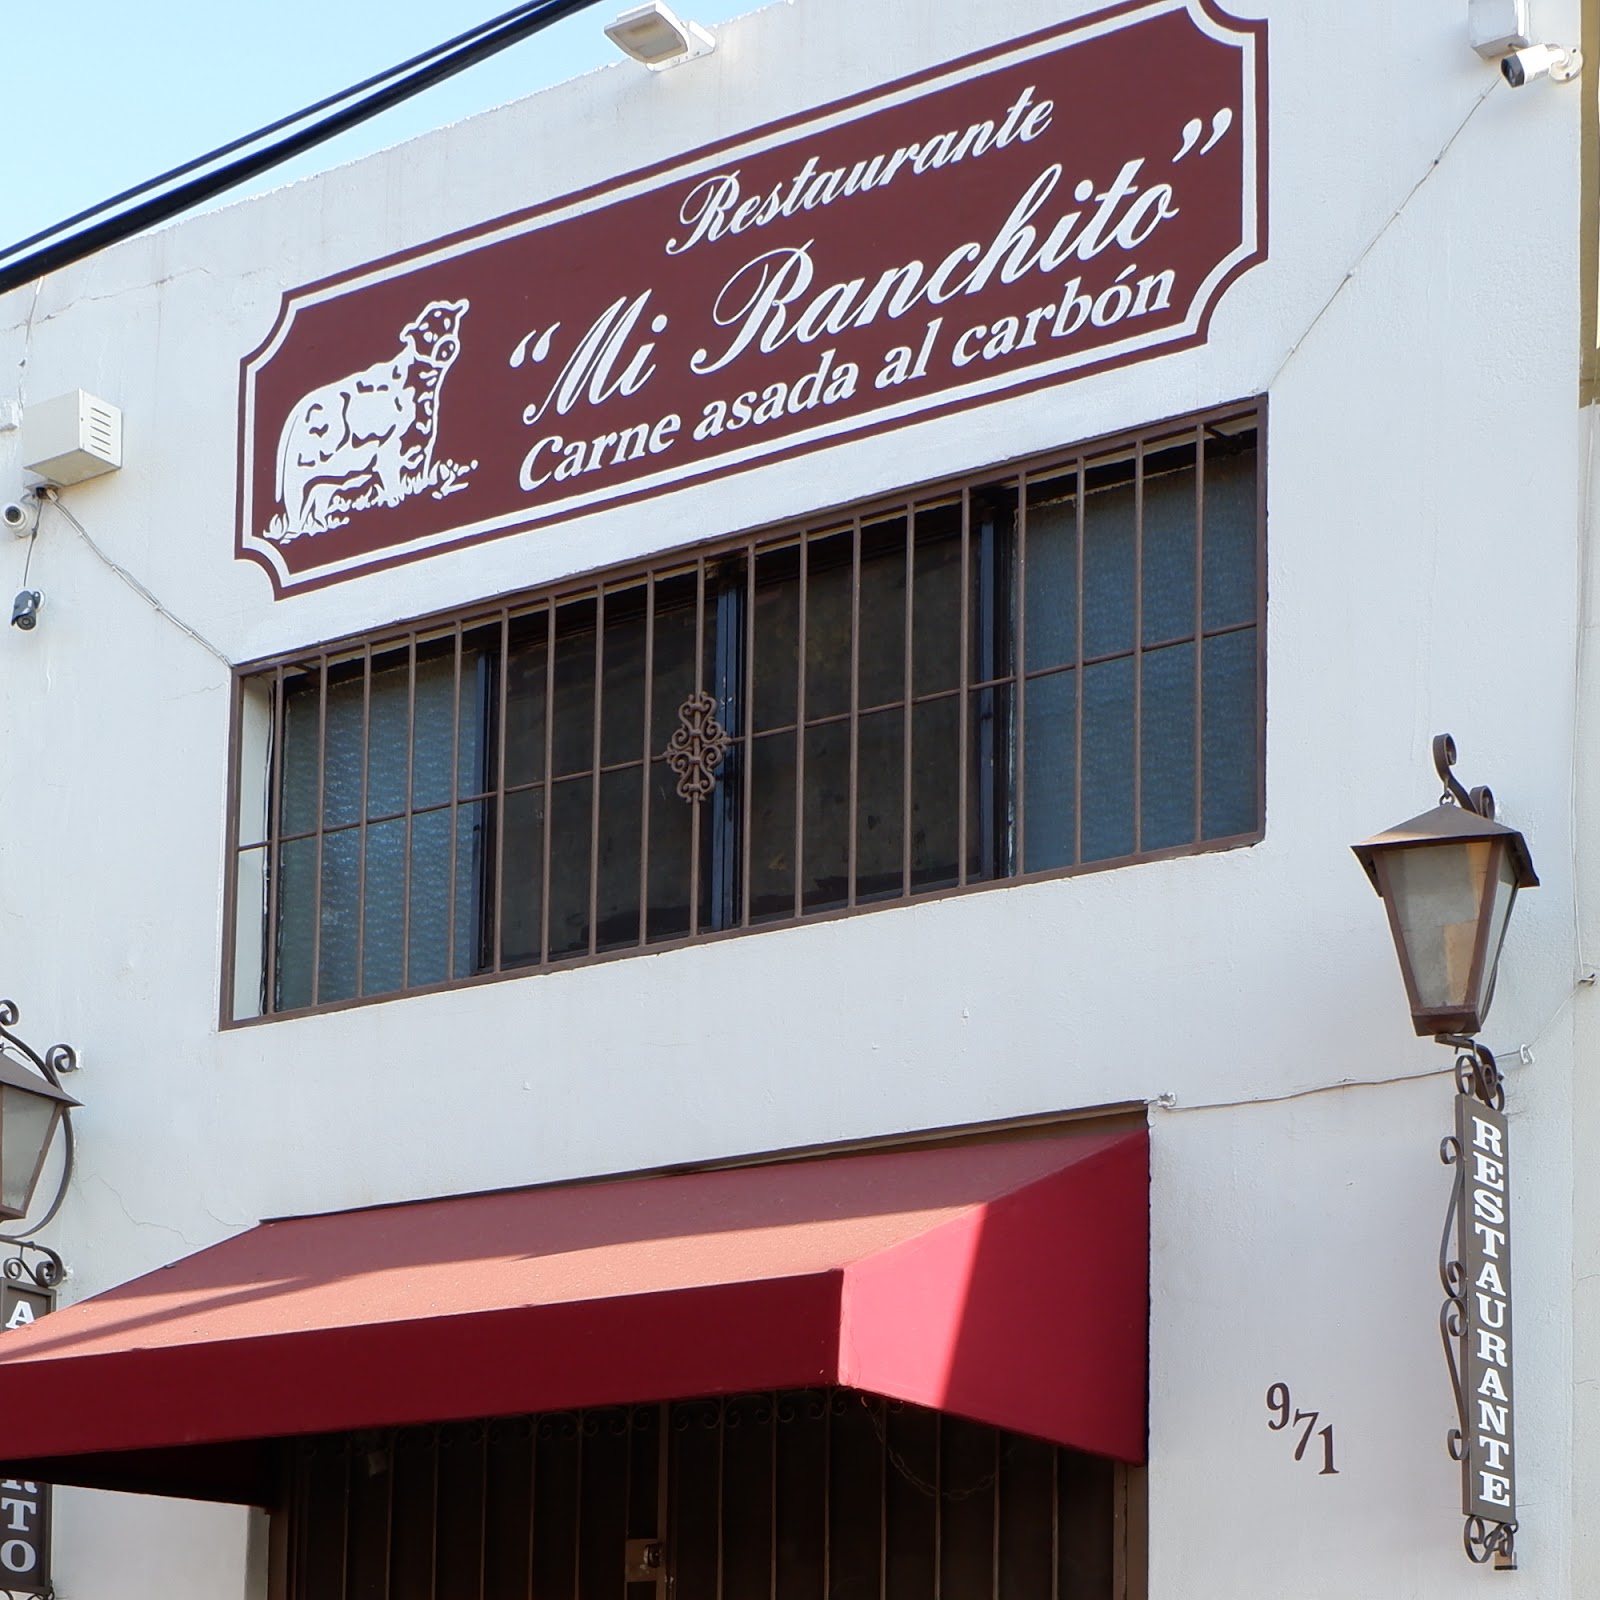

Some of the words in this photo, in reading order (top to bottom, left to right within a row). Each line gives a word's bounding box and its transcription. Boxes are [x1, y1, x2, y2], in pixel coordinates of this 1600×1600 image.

[666, 86, 1053, 254] Restaurante
[519, 414, 681, 491] Carne
[693, 348, 858, 440] asada
[875, 317, 943, 388] al
[952, 264, 1175, 366] carbón
[1472, 1116, 1510, 1508] RESTAURANTE
[1266, 1382, 1340, 1475] 971
